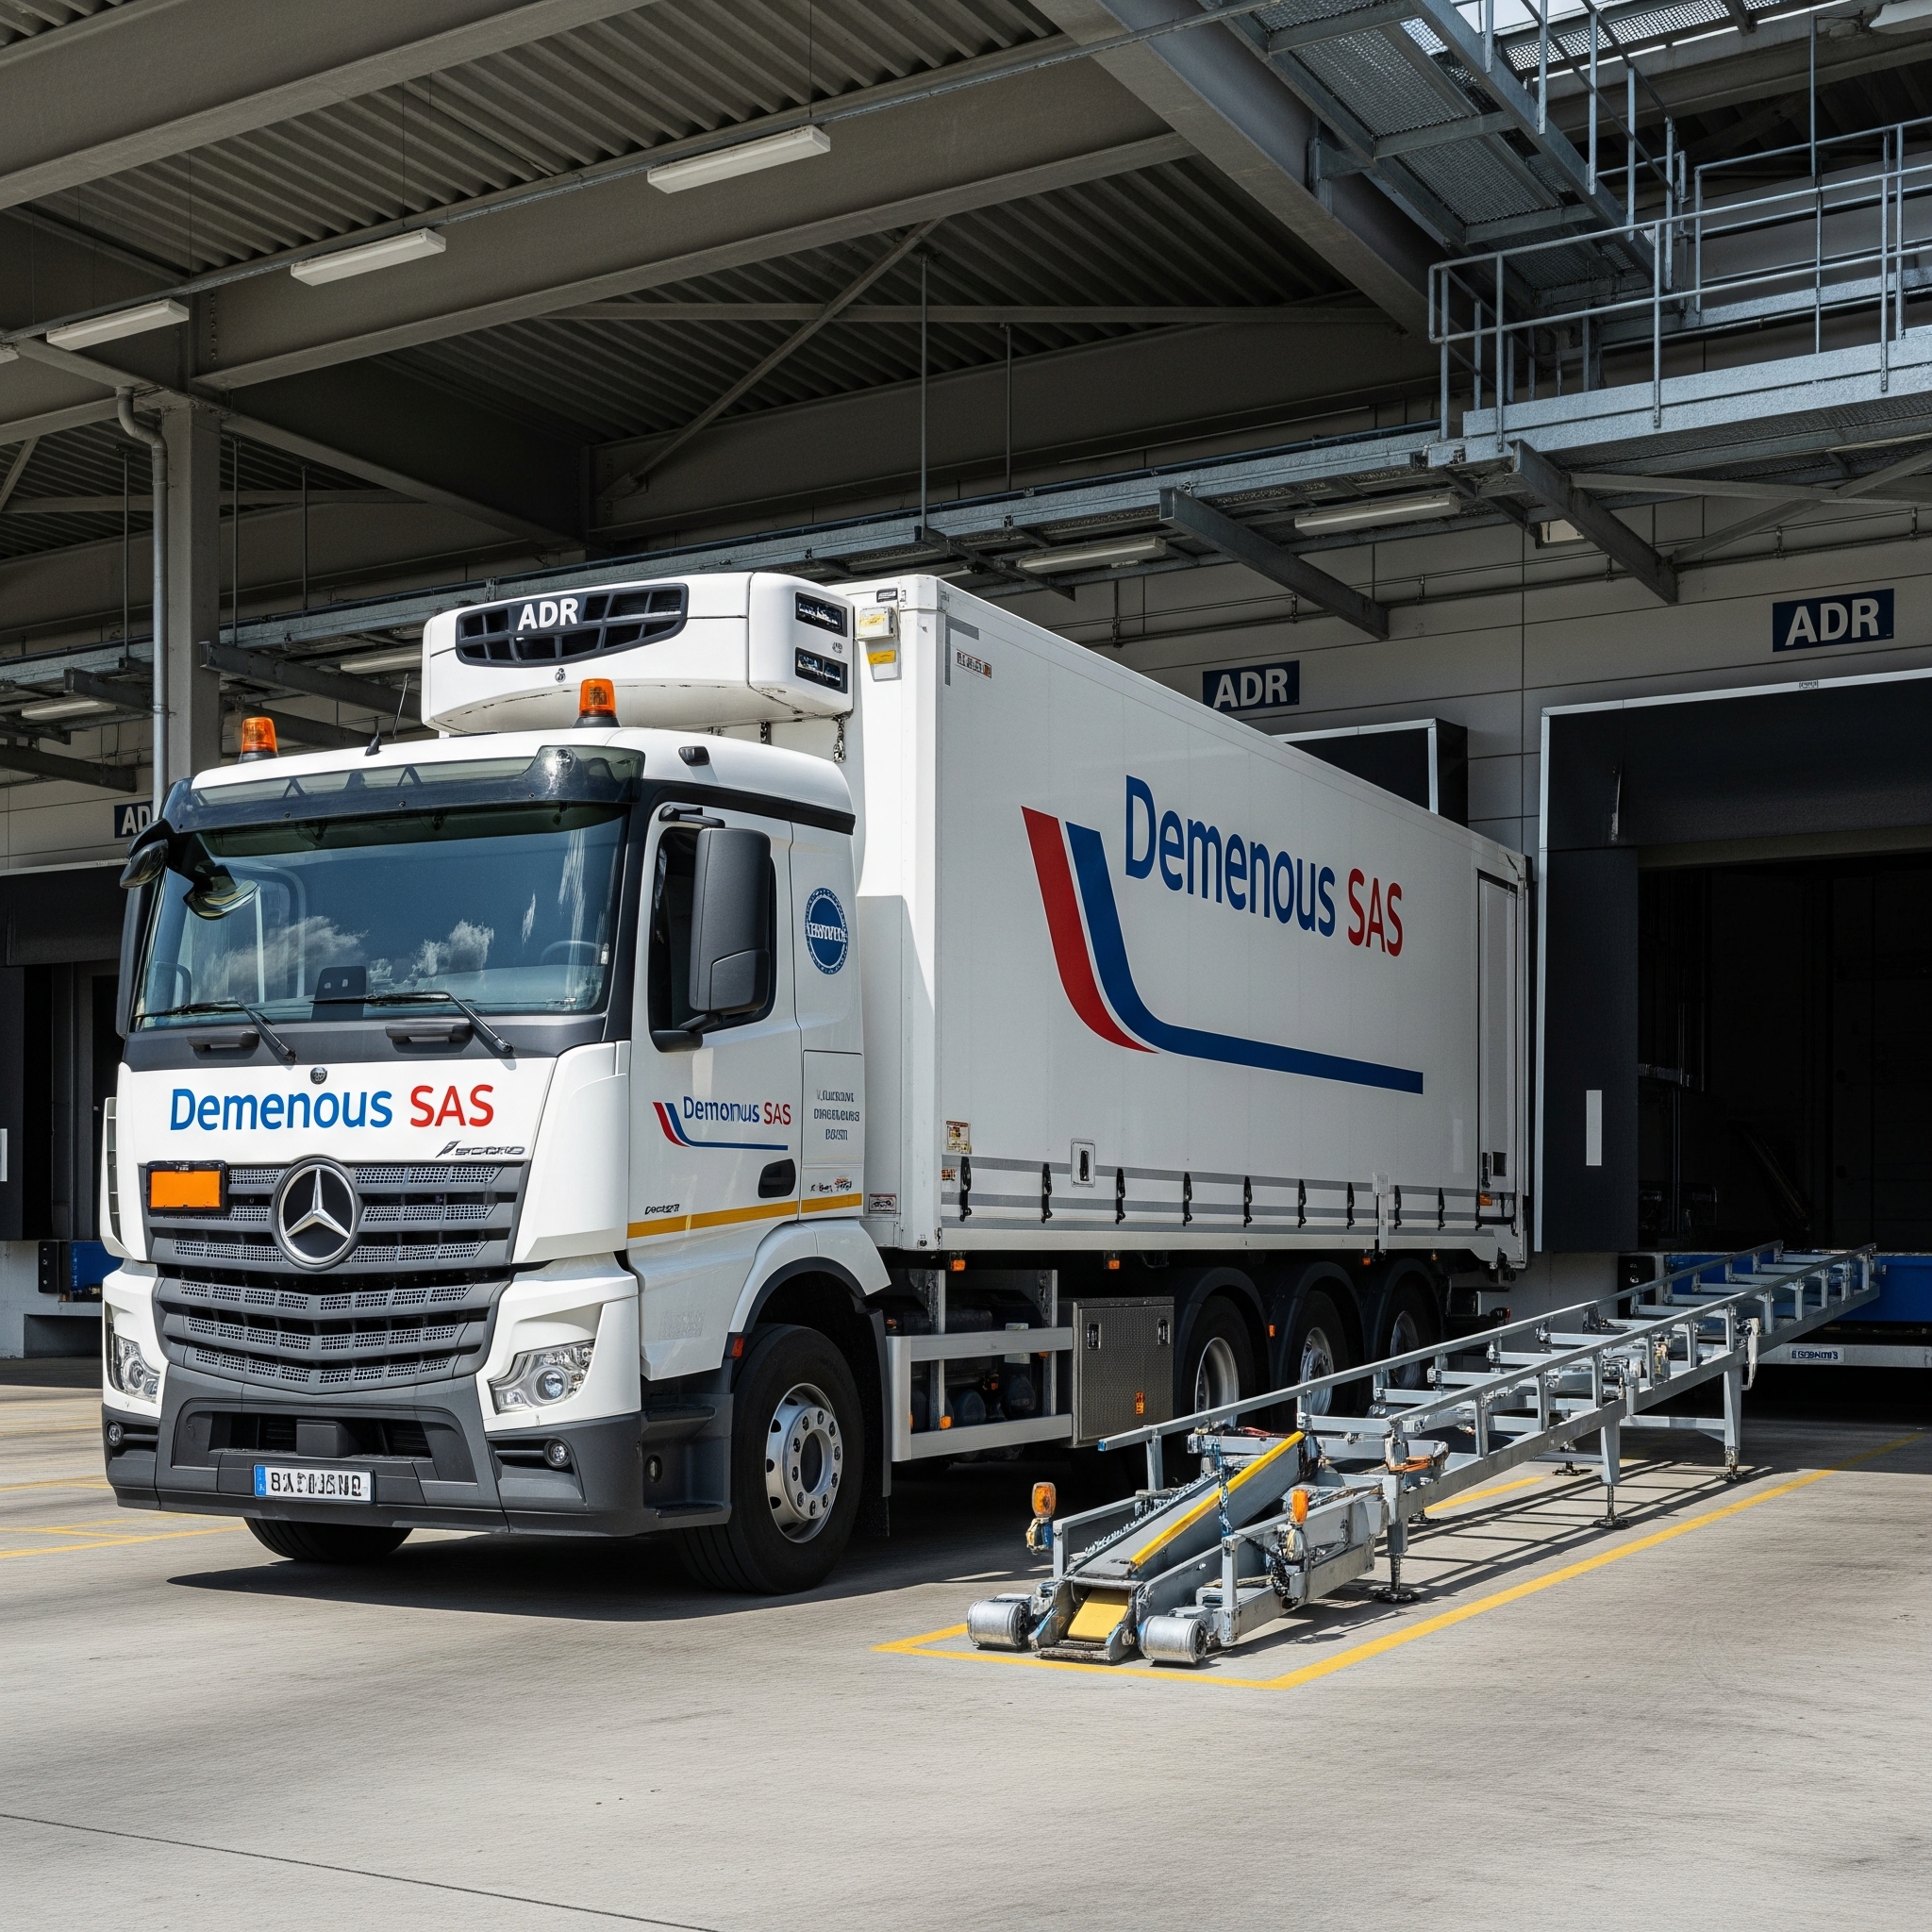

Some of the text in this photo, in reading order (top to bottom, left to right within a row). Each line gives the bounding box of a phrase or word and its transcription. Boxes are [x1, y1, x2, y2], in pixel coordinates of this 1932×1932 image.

[517, 597, 579, 631] ADR
[1785, 597, 1879, 646] ADR
[1212, 668, 1289, 709] ADR
[121, 805, 152, 835] AD
[1125, 774, 1403, 958] Demenous SAS
[170, 1084, 494, 1131] Demenous SAS
[763, 1101, 791, 1125] SAS
